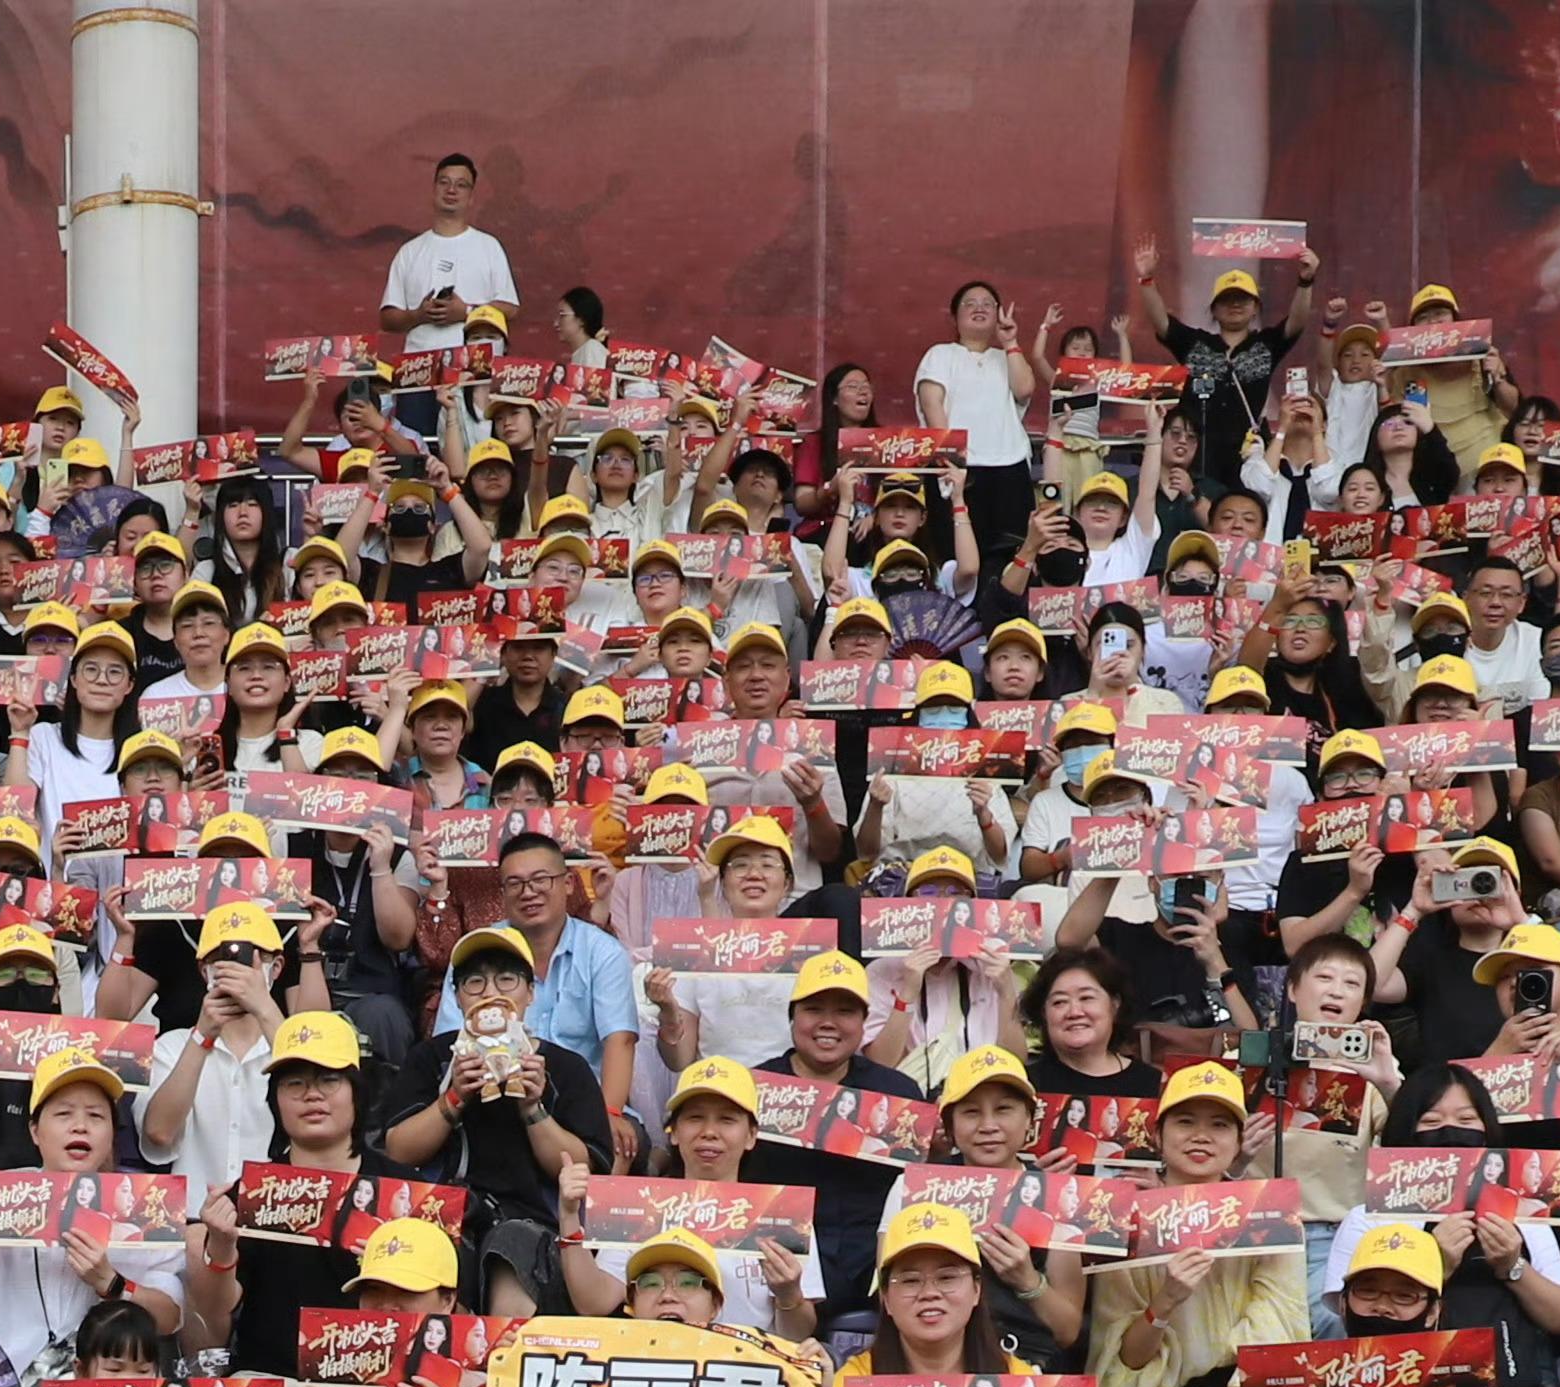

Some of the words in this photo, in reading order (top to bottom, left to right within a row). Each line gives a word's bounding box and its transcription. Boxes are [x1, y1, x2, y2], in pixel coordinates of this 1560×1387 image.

[1385, 1156, 1461, 1191] 开机大吉
[1146, 1197, 1242, 1247] 陈丽君
[307, 1316, 398, 1349] 开机大吉
